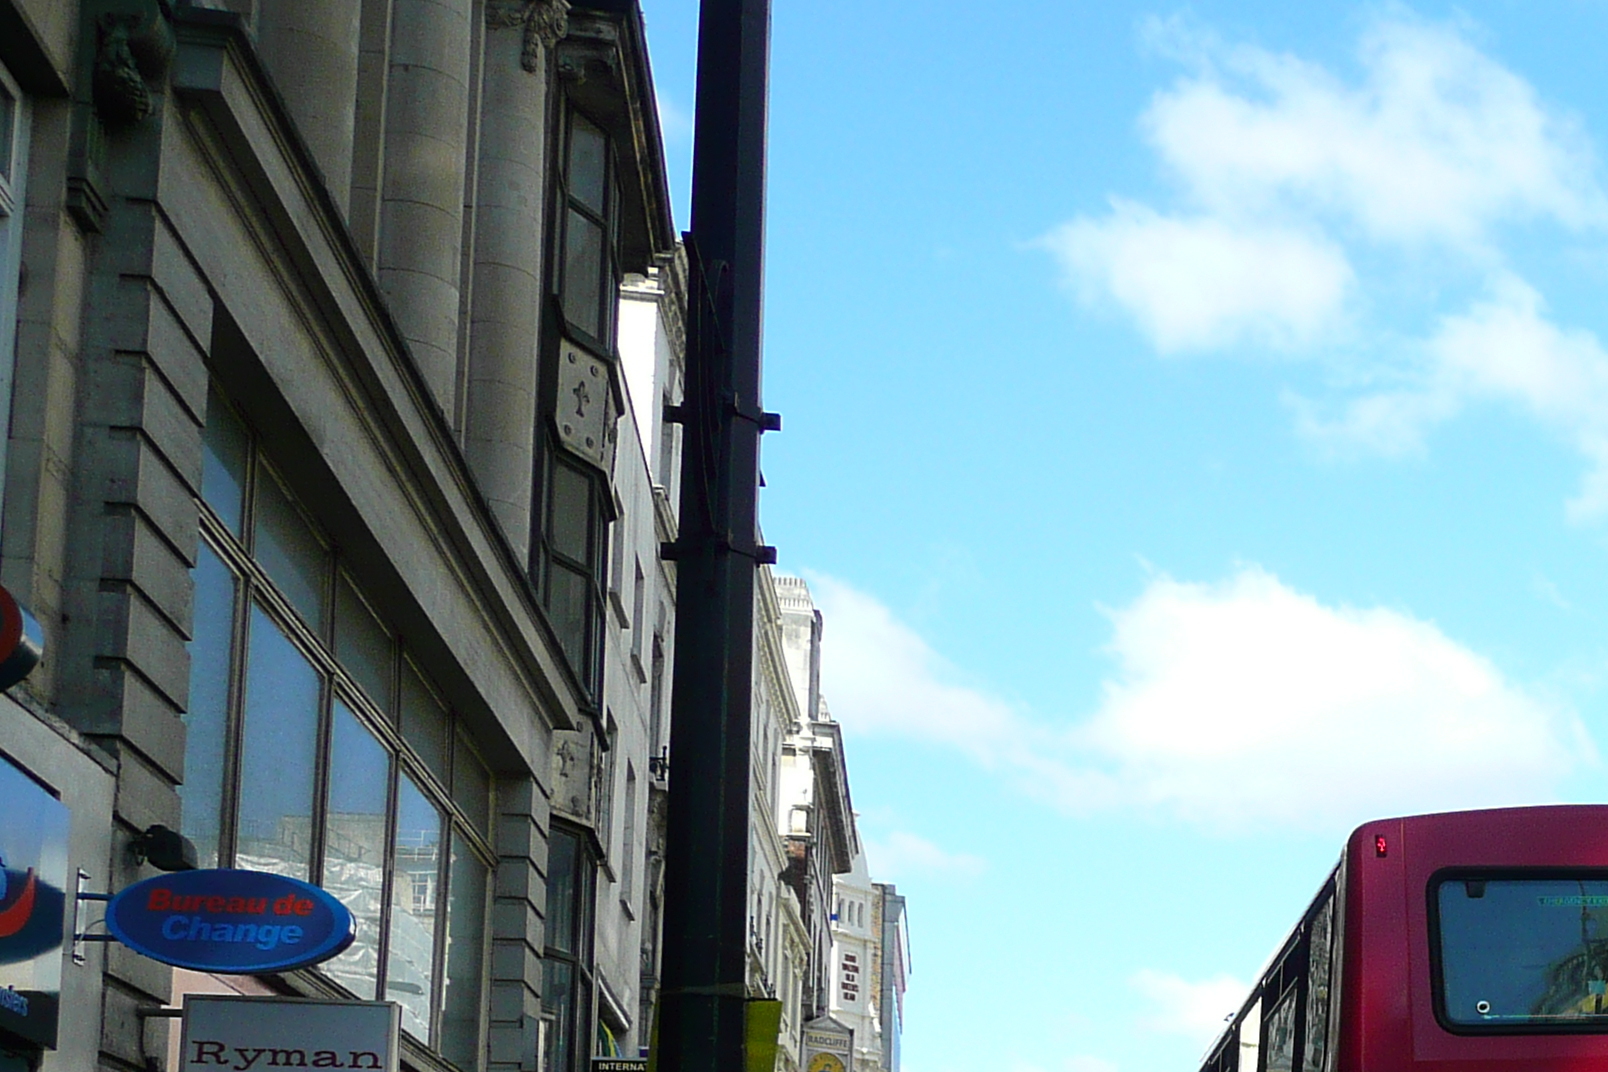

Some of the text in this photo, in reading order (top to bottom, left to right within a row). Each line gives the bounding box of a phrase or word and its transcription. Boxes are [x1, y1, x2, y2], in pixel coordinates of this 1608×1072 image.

[147, 888, 314, 916] Bureau de
[162, 915, 304, 949] Change
[190, 1040, 383, 1071] Ryman
[808, 1035, 848, 1048] RADCLIFFE
